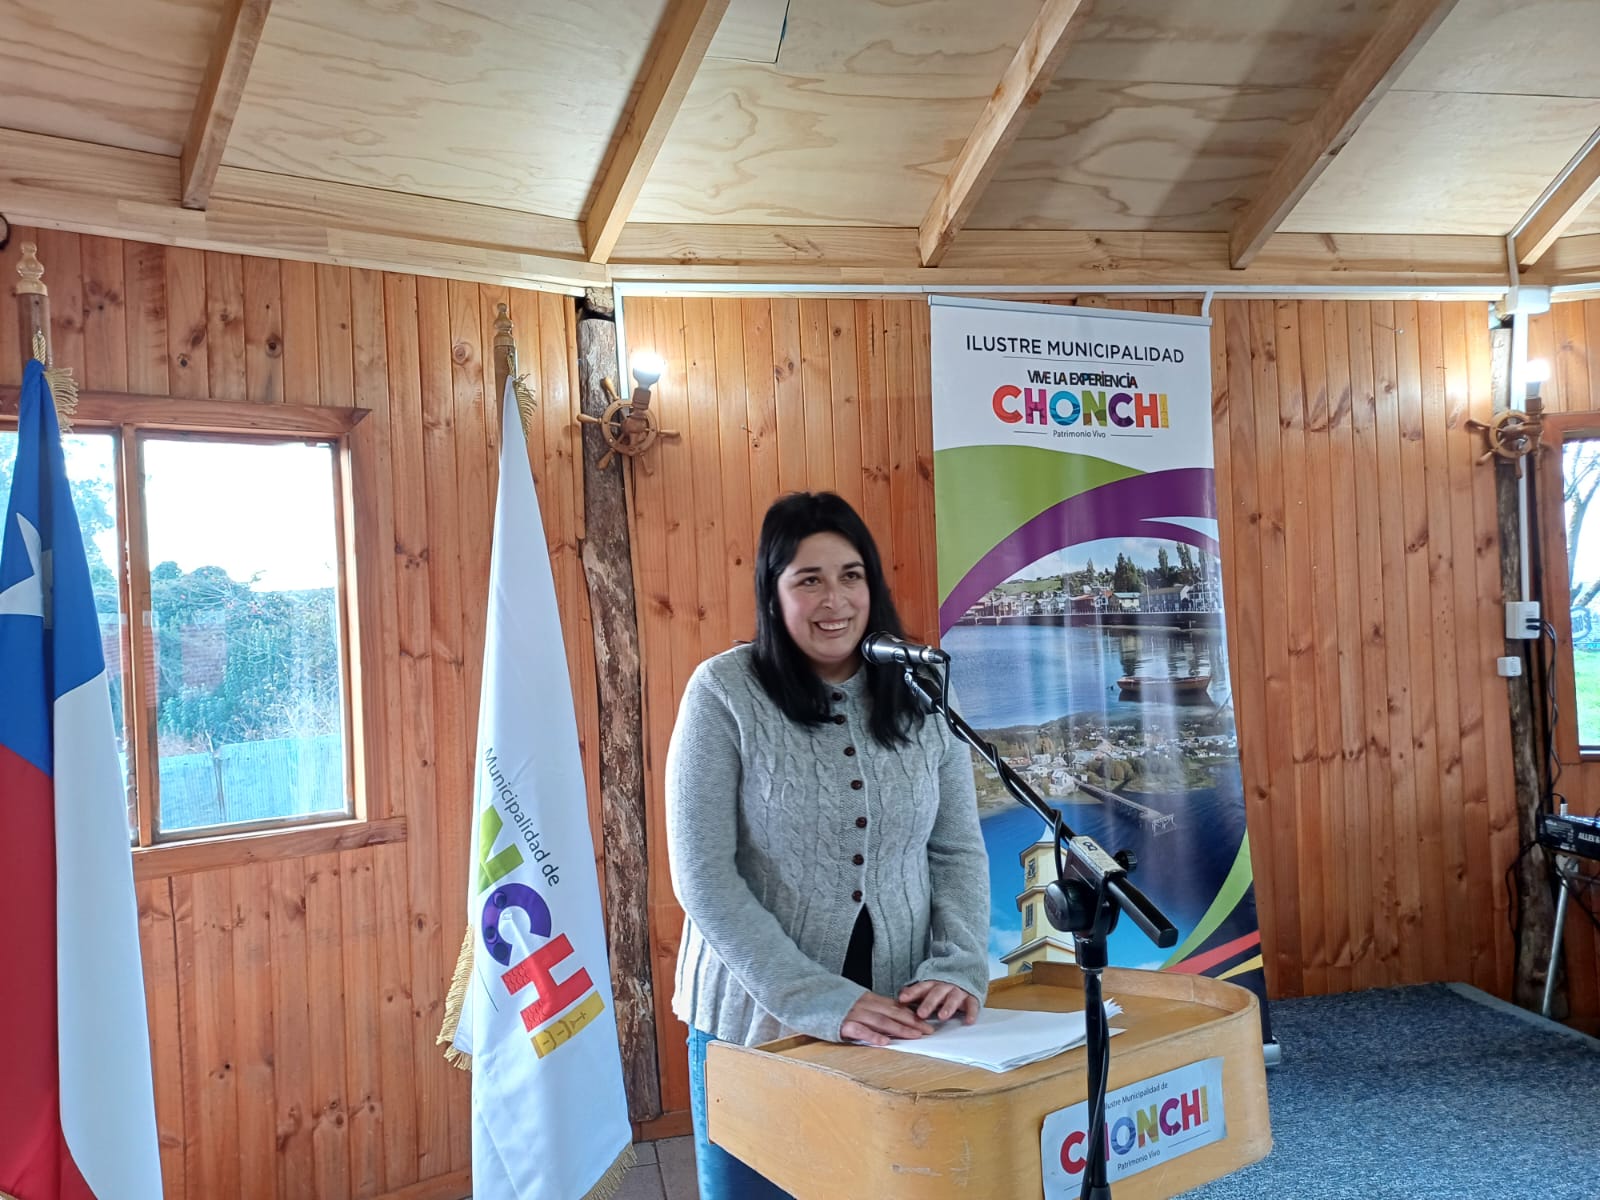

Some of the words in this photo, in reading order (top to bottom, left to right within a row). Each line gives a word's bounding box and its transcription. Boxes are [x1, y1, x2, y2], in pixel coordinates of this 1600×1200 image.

[966, 335, 1041, 355] ILUSTRE
[1047, 340, 1184, 363] MUNICIPALIDAD
[1027, 370, 1051, 384] VIVE
[1053, 371, 1068, 385] LA
[992, 385, 1170, 428] CHONCHI
[1053, 430, 1091, 438] Patrimonio
[1093, 430, 1106, 438] Vivo
[485, 747, 551, 863] Municipalidad
[541, 863, 560, 887] de
[1104, 1099, 1121, 1109] lustre
[1122, 1083, 1160, 1104] Municipalidad
[1161, 1081, 1168, 1089] de
[1117, 1155, 1148, 1171] Patrimonio
[1147, 1149, 1161, 1161] Vivo
